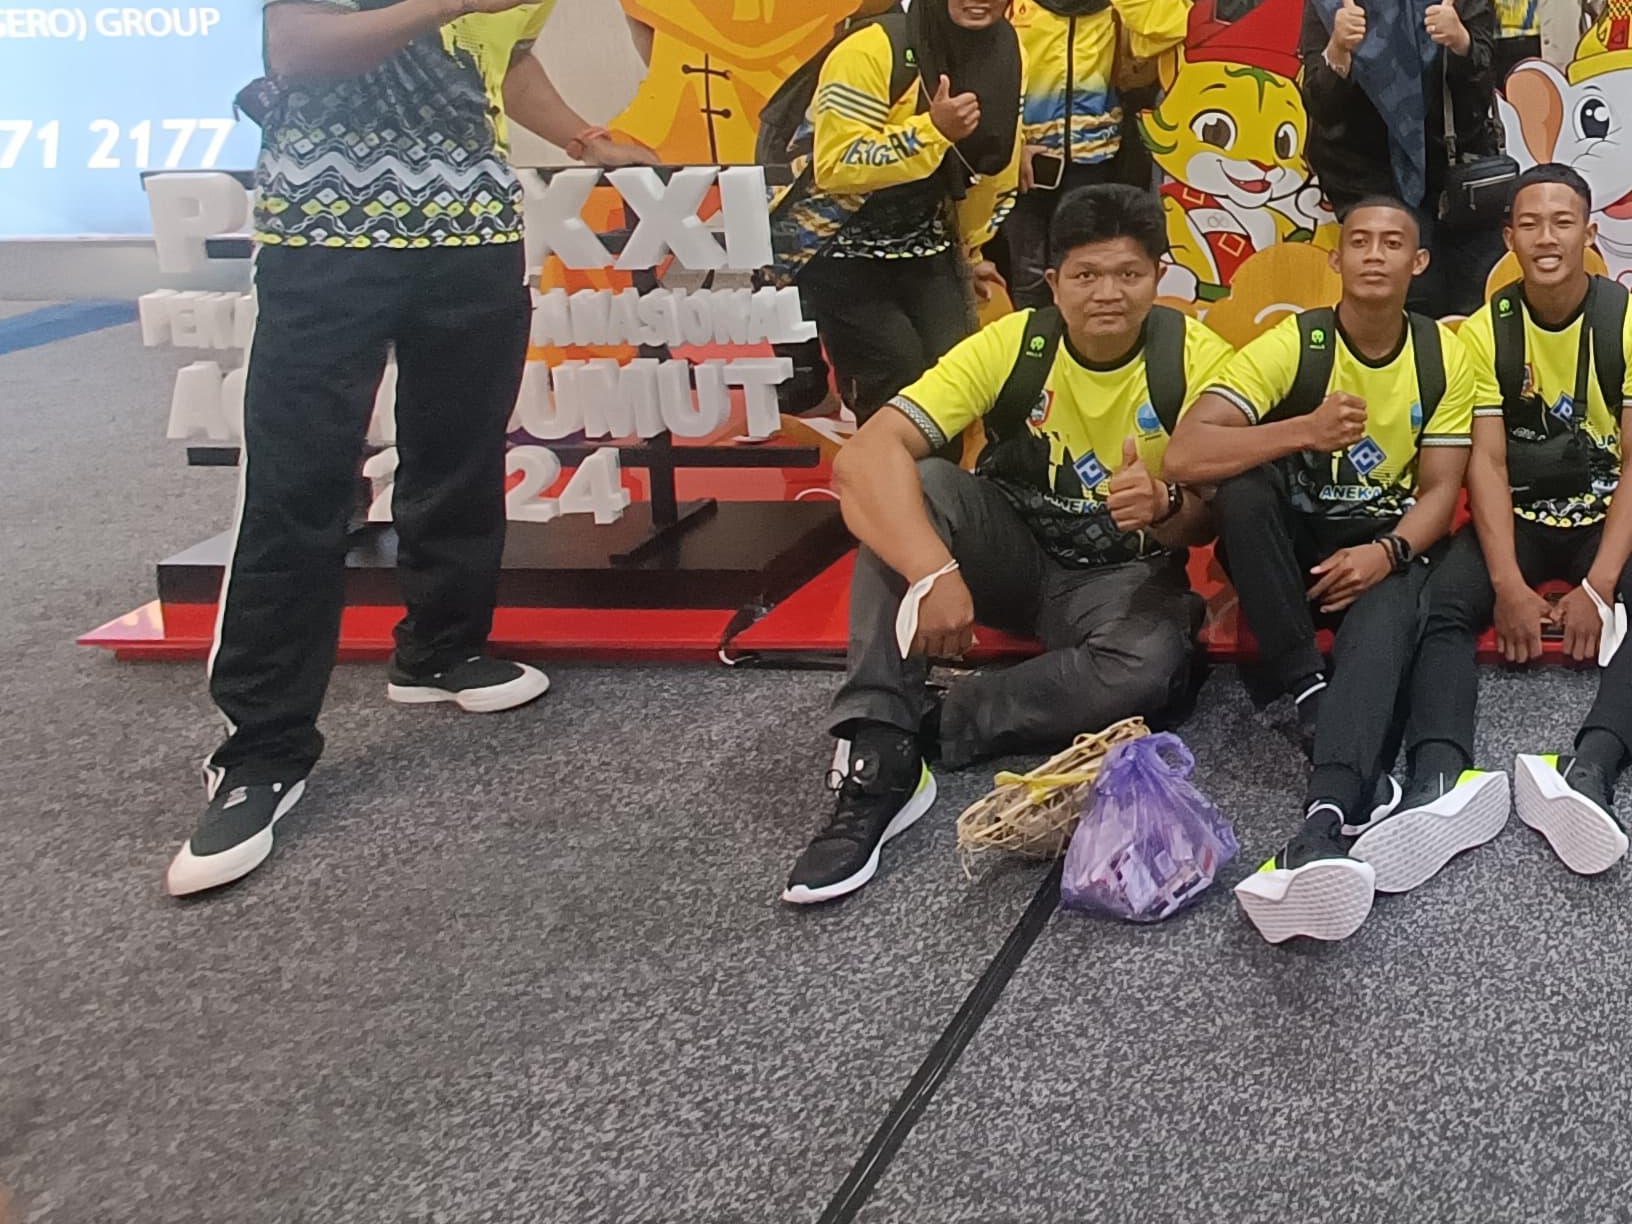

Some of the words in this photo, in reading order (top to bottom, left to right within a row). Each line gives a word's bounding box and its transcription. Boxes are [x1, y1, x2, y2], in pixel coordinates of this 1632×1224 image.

[96, 7, 220, 38] GROUP
[87, 118, 237, 169] 2177
[506, 357, 795, 440] UMUT
